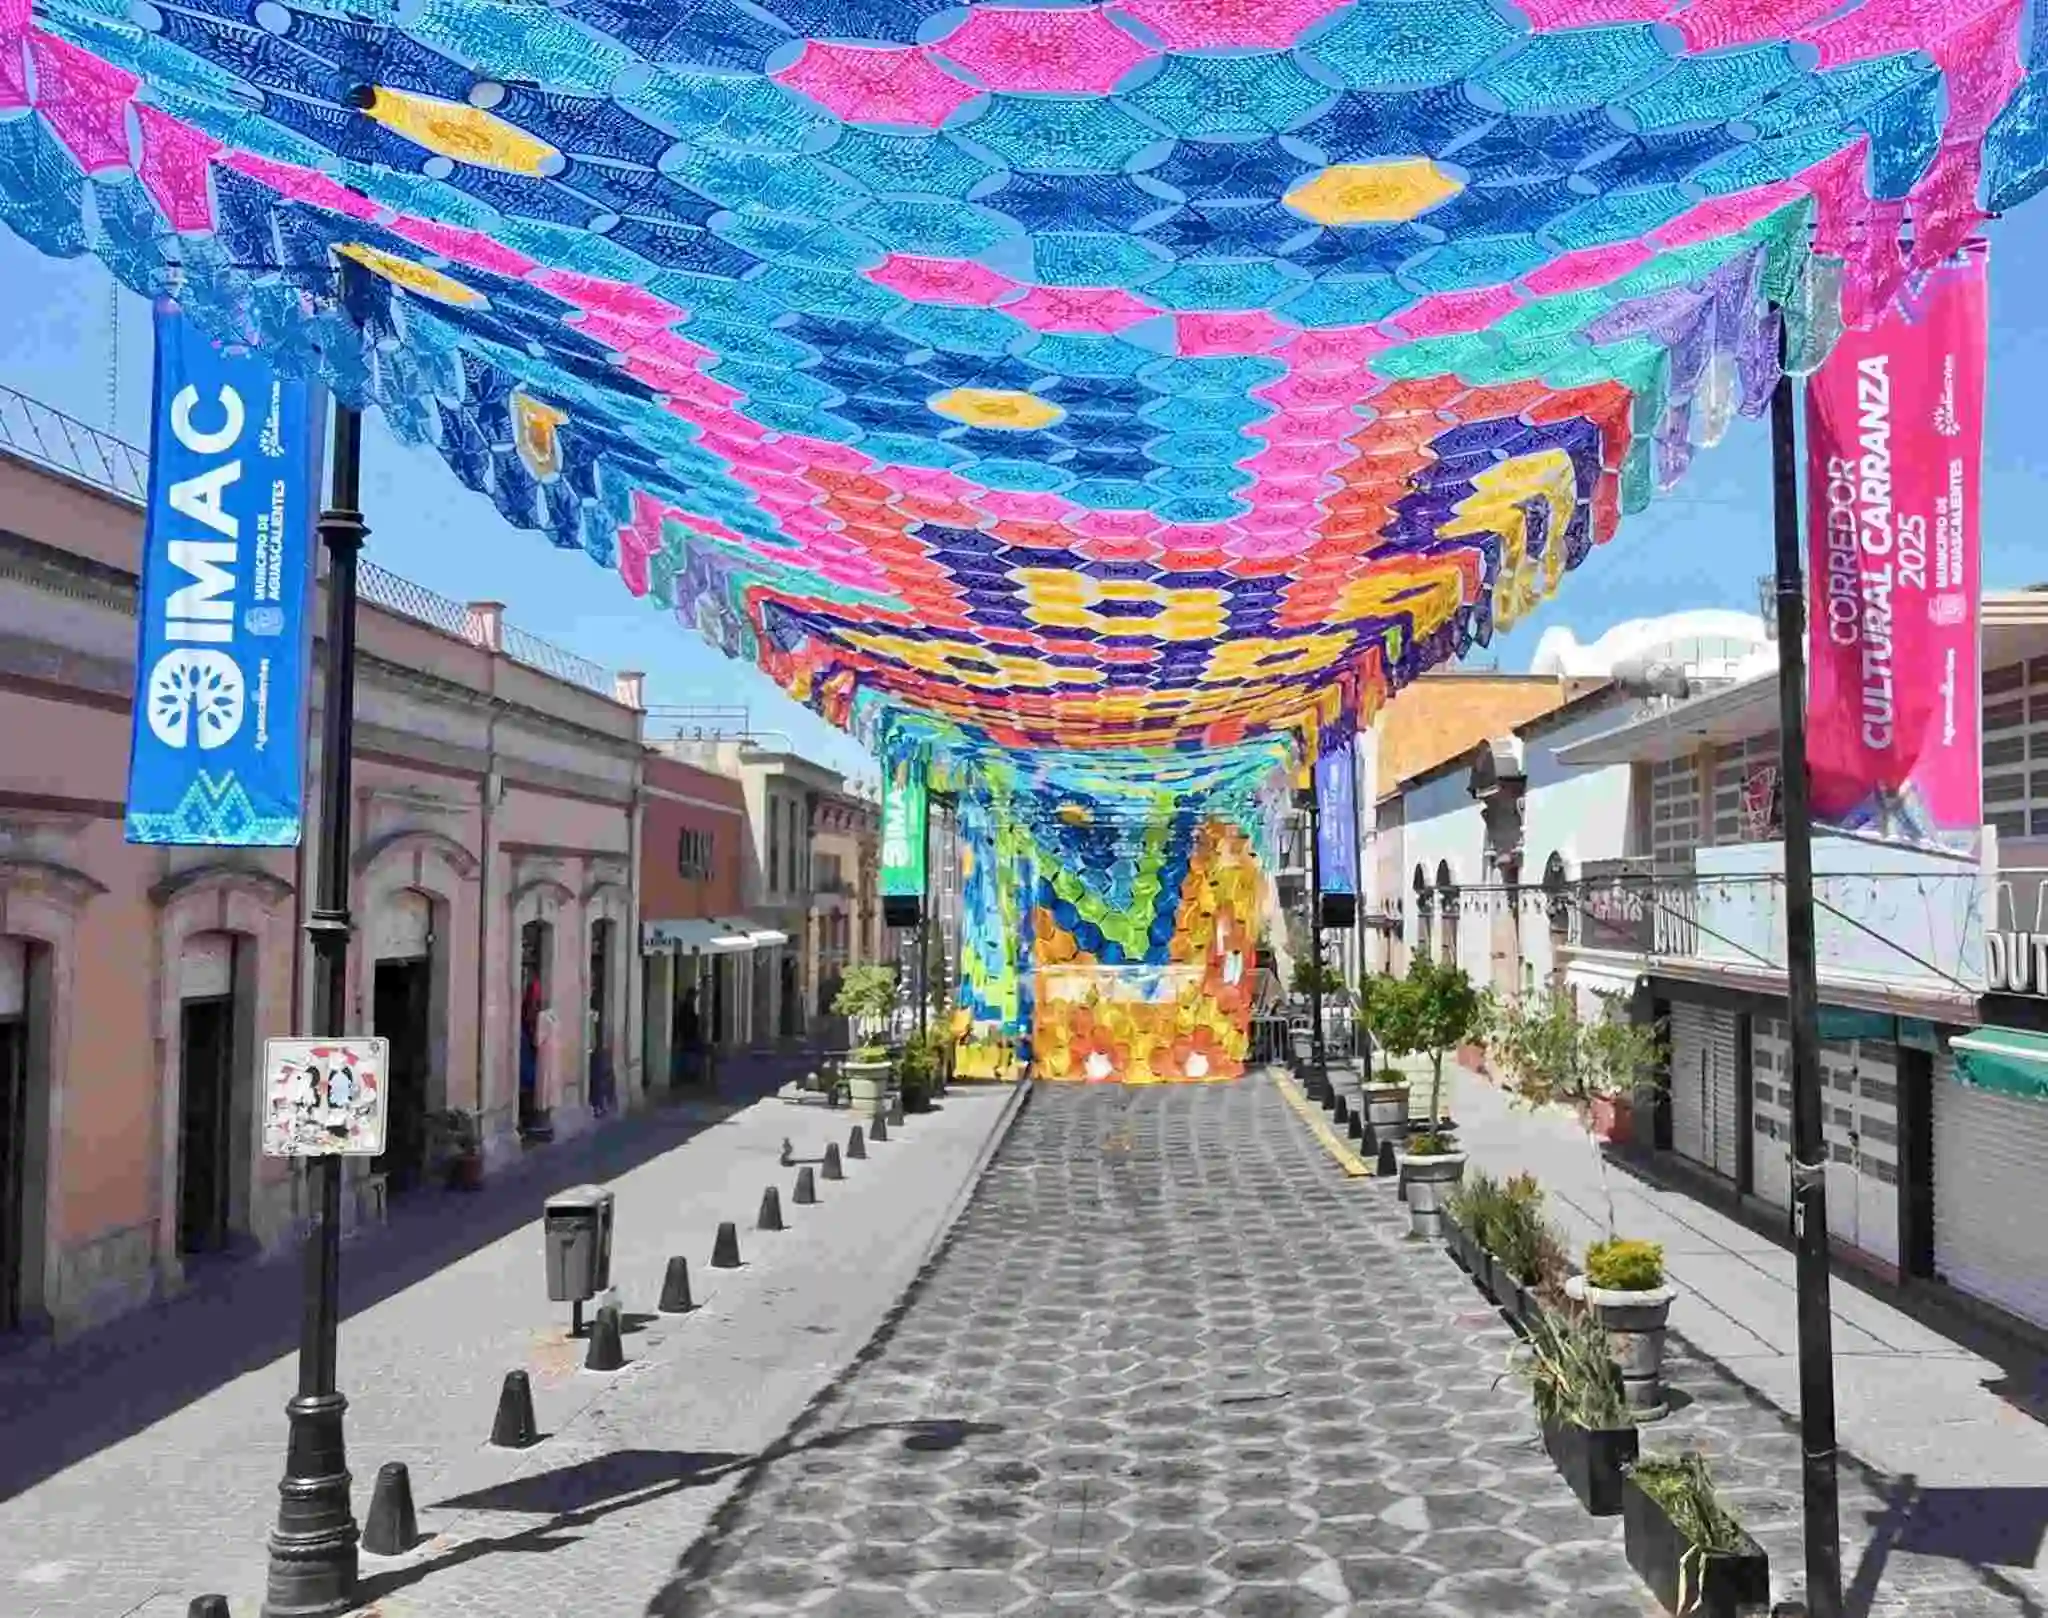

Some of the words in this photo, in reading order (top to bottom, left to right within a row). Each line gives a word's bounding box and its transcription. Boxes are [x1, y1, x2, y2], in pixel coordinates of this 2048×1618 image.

[165, 383, 245, 643] IMAC
[1857, 354, 1892, 555] CARRANZA
[254, 531, 269, 601] MUNICIPIO
[257, 513, 270, 530] DE
[268, 479, 285, 601] AGUASCALIENTES
[1827, 456, 1858, 645] CORREDOR
[1898, 512, 1926, 590] 2025
[1935, 516, 1949, 588] MUNICIPIO
[1861, 563, 1893, 749] CULTURAL
